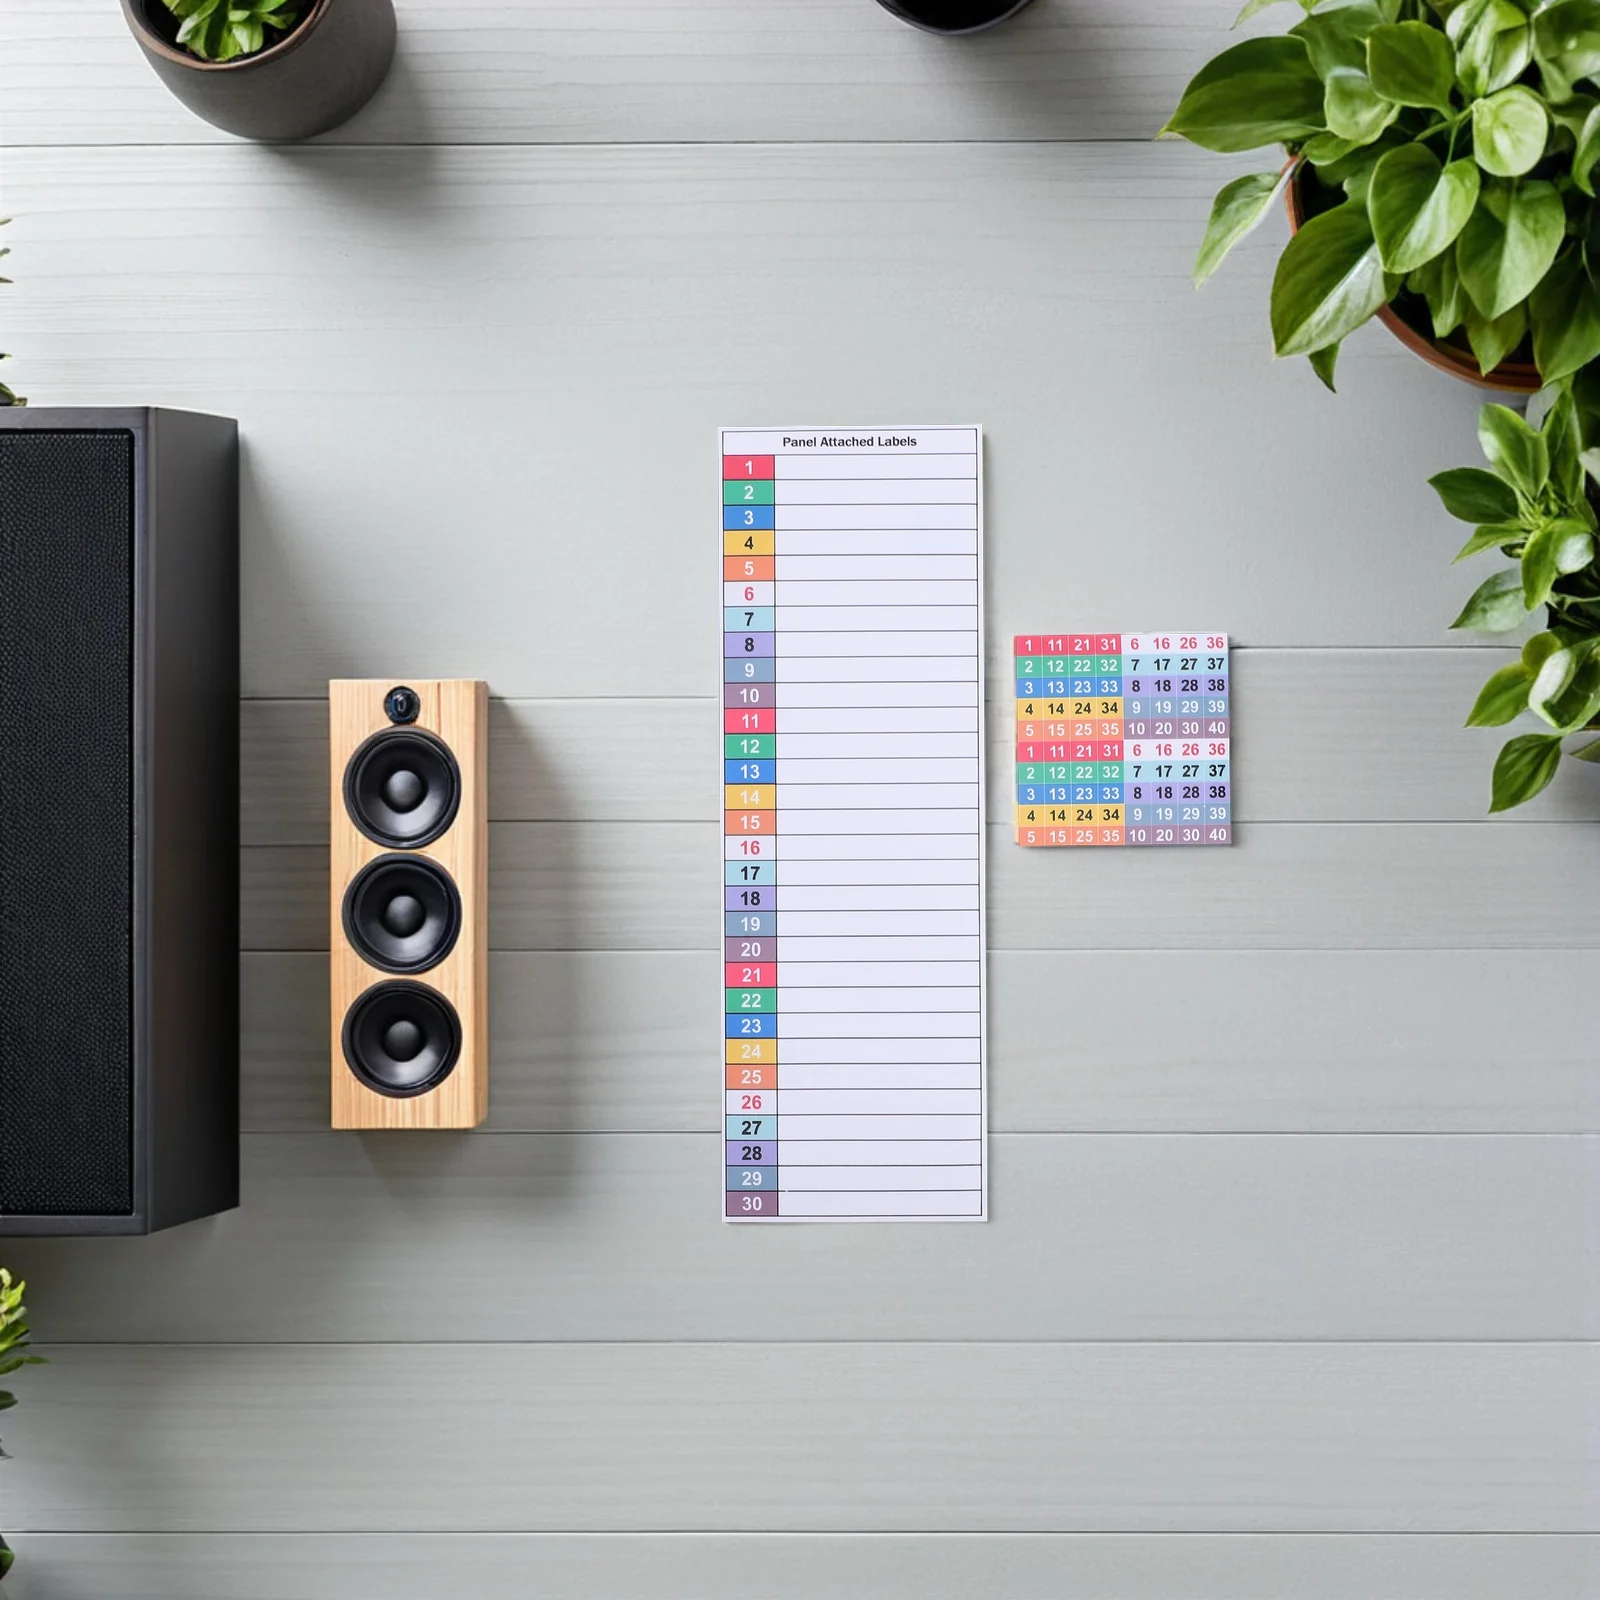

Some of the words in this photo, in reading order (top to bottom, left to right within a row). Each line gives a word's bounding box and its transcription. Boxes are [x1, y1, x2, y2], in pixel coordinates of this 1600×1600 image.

[782, 436, 817, 448] Panel
[820, 436, 874, 447] Attached
[877, 436, 917, 447] Labels
[745, 460, 753, 475] 1
[744, 485, 754, 500] 2
[744, 510, 754, 525] 3
[744, 536, 754, 550] 4
[744, 560, 754, 576] 5
[744, 586, 754, 601] 6
[744, 612, 754, 626] 7
[744, 637, 754, 652] 8
[1026, 639, 1032, 652] 1
[1048, 639, 1062, 651] 11
[1074, 639, 1090, 651] 21
[1101, 638, 1116, 651] 31
[1130, 638, 1139, 650] 6
[1153, 637, 1170, 650] 16
[1180, 637, 1197, 649] 26
[1207, 637, 1224, 649] 36
[745, 663, 754, 677] 9
[1025, 660, 1033, 673] 2
[1047, 660, 1064, 672] 12
[1074, 659, 1091, 672] 22
[1101, 659, 1117, 672] 32
[1131, 659, 1140, 671] 7
[1154, 658, 1170, 671] 17
[1181, 658, 1198, 670] 27
[1208, 658, 1224, 670] 37
[1025, 681, 1033, 694] 3
[1048, 681, 1064, 694] 13
[1074, 681, 1091, 693] 23
[1101, 680, 1118, 693] 33
[1132, 680, 1140, 692] 8
[1154, 680, 1171, 692] 18
[1181, 679, 1198, 691] 28
[1208, 679, 1225, 691] 38
[740, 688, 759, 703] 10
[1025, 703, 1033, 715] 4
[1048, 703, 1064, 714] 14
[1075, 702, 1091, 714] 24
[1102, 702, 1118, 714] 34
[1132, 701, 1141, 714] 9
[1155, 701, 1171, 713] 19
[1182, 700, 1199, 713] 29
[1208, 700, 1225, 713] 39
[742, 714, 759, 728] 11
[1026, 724, 1034, 737] 5
[1048, 724, 1065, 736] 15
[1075, 723, 1092, 736] 25
[1102, 723, 1119, 735] 35
[1129, 722, 1145, 735] 10
[1155, 722, 1172, 735] 20
[1182, 722, 1199, 734] 30
[1208, 721, 1225, 734] 40
[741, 739, 760, 753] 12
[1027, 746, 1034, 758] 1
[1050, 745, 1064, 758] 11
[1076, 745, 1092, 757] 21
[1104, 744, 1118, 757] 31
[1133, 744, 1142, 757] 6
[1156, 743, 1172, 756] 16
[1182, 743, 1199, 756] 26
[1209, 743, 1225, 756] 36
[740, 764, 760, 779] 13
[1027, 767, 1035, 780] 2
[1049, 767, 1066, 779] 12
[1076, 766, 1093, 779] 22
[1103, 766, 1119, 778] 32
[1133, 765, 1142, 778] 7
[1156, 765, 1172, 777] 17
[1182, 765, 1199, 777] 27
[1209, 764, 1226, 777] 37
[741, 790, 760, 805] 14
[1027, 788, 1035, 801] 3
[1049, 788, 1066, 800] 13
[1076, 787, 1093, 800] 23
[1103, 787, 1120, 800] 33
[1134, 787, 1142, 799] 8
[1156, 786, 1172, 799] 18
[1183, 786, 1200, 798] 28
[1209, 786, 1226, 798] 38
[1027, 810, 1035, 821] 4
[1050, 810, 1066, 821] 14
[1076, 809, 1093, 821] 24
[1103, 809, 1119, 821] 34
[1134, 808, 1142, 820] 9
[1156, 808, 1173, 820] 19
[1183, 807, 1200, 820] 29
[1209, 807, 1226, 820] 39
[741, 815, 760, 830] 15
[1027, 831, 1036, 843] 5
[1050, 830, 1067, 843] 15
[1076, 830, 1093, 843] 25
[1103, 830, 1120, 842] 35
[1130, 829, 1146, 842] 10
[1156, 829, 1173, 841] 20
[1183, 829, 1200, 841] 30
[1209, 828, 1226, 841] 40
[741, 840, 760, 855] 16
[741, 866, 760, 880] 17
[741, 891, 760, 906] 18
[741, 917, 760, 931] 19
[741, 942, 761, 957] 20
[742, 968, 761, 983] 21
[741, 993, 761, 1008] 22
[741, 1018, 762, 1033] 23
[741, 1043, 762, 1059] 24
[741, 1069, 762, 1084] 25
[741, 1095, 762, 1110] 26
[742, 1121, 762, 1135] 27
[742, 1146, 762, 1160] 28
[742, 1171, 762, 1186] 29
[742, 1196, 762, 1211] 30
